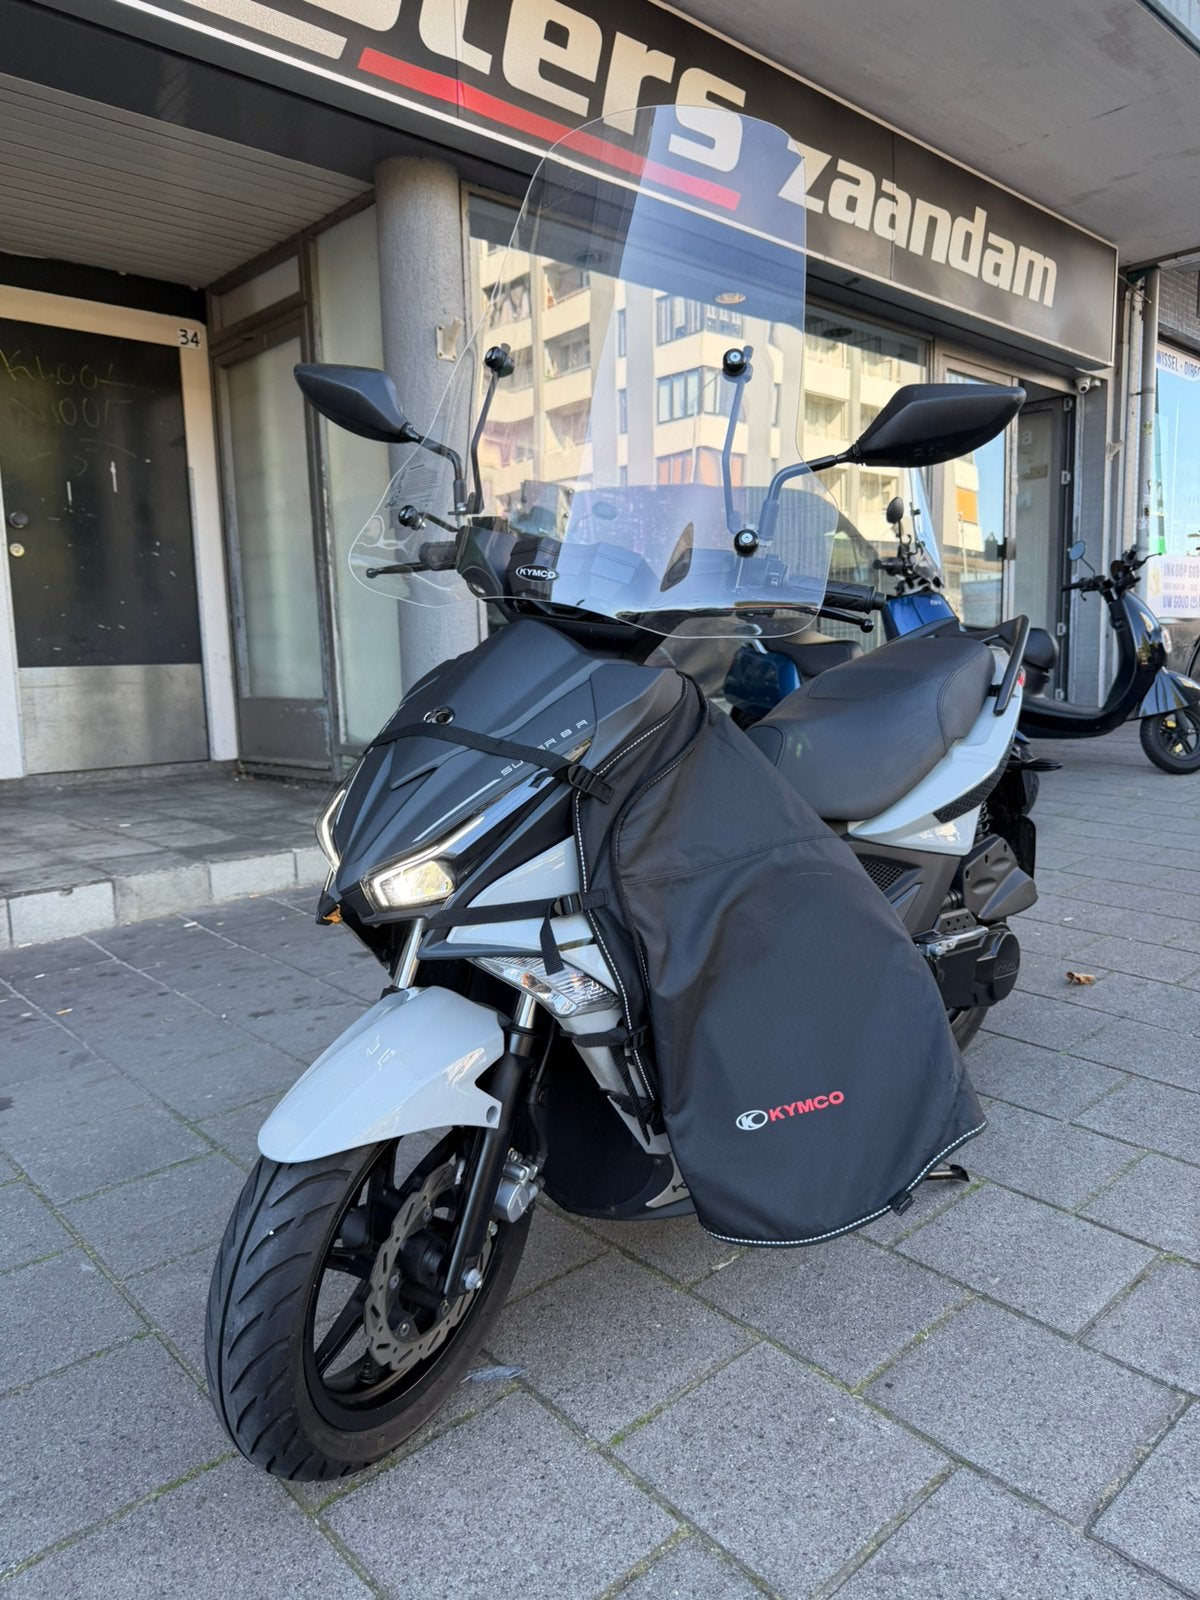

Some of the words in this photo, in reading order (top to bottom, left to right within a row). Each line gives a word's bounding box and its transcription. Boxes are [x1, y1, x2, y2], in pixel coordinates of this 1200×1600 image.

[778, 137, 1058, 308] zaandam
[179, 328, 200, 348] 34
[519, 567, 556, 580] KYMCO
[769, 1090, 845, 1122] KYMCO
